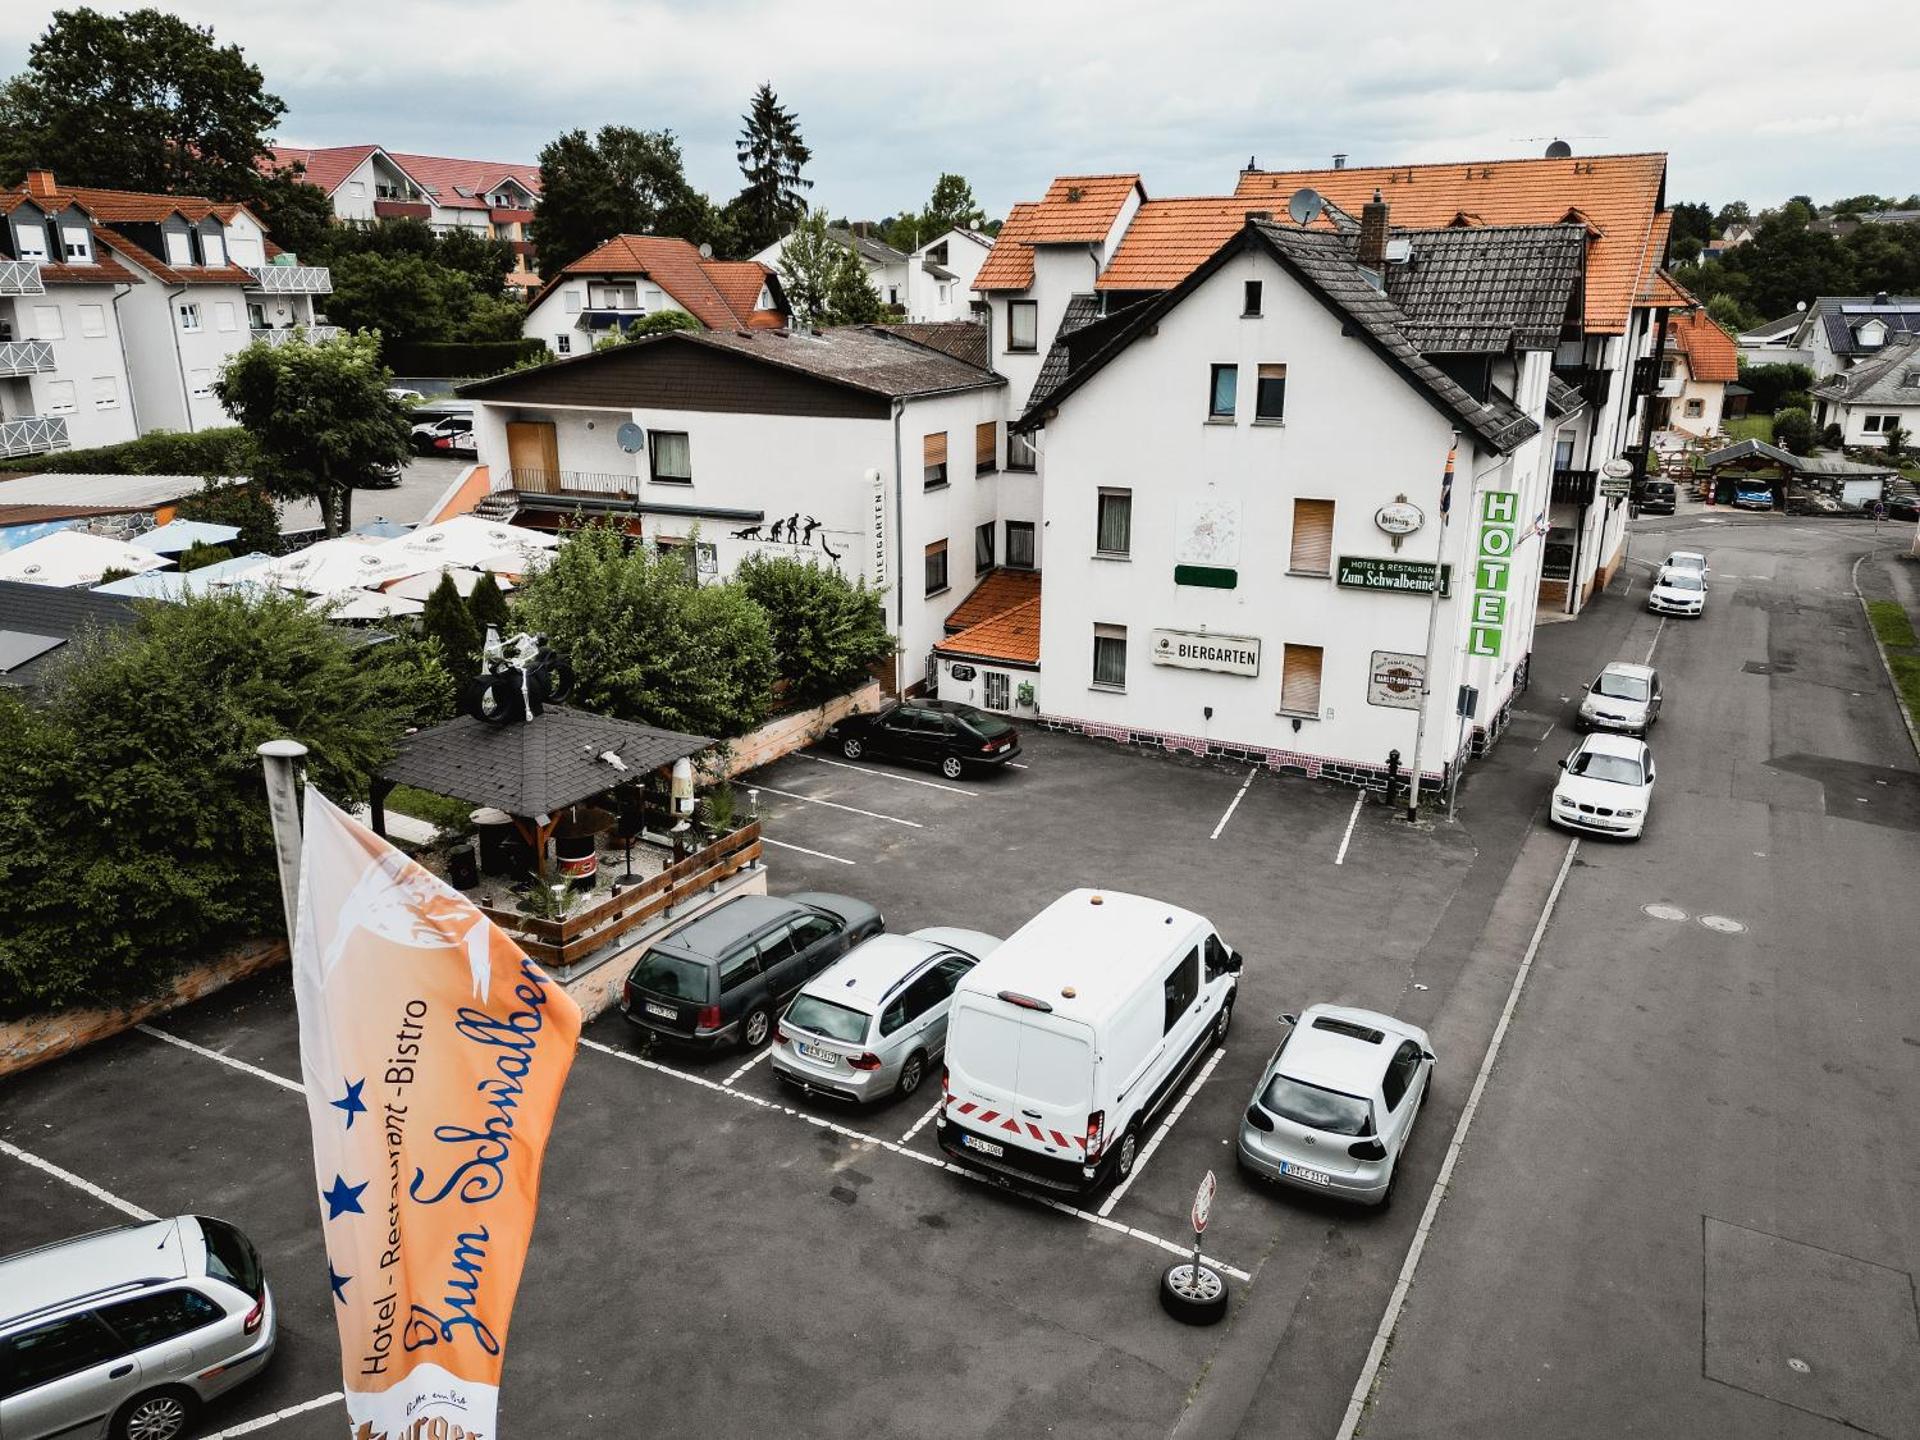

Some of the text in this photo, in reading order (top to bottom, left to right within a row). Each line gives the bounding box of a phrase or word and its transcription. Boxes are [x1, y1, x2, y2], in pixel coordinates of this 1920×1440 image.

[875, 494, 884, 583] BIERGARTEN
[1351, 561, 1376, 570] HOTEL
[1387, 564, 1436, 574] RESTAURAN
[1475, 494, 1514, 654] HOTEL
[1341, 568, 1445, 592] Zum Schwalbennet
[1178, 644, 1256, 665] BIERGARTEN
[403, 1225, 500, 1356] Zum
[361, 1292, 398, 1374] Hotel
